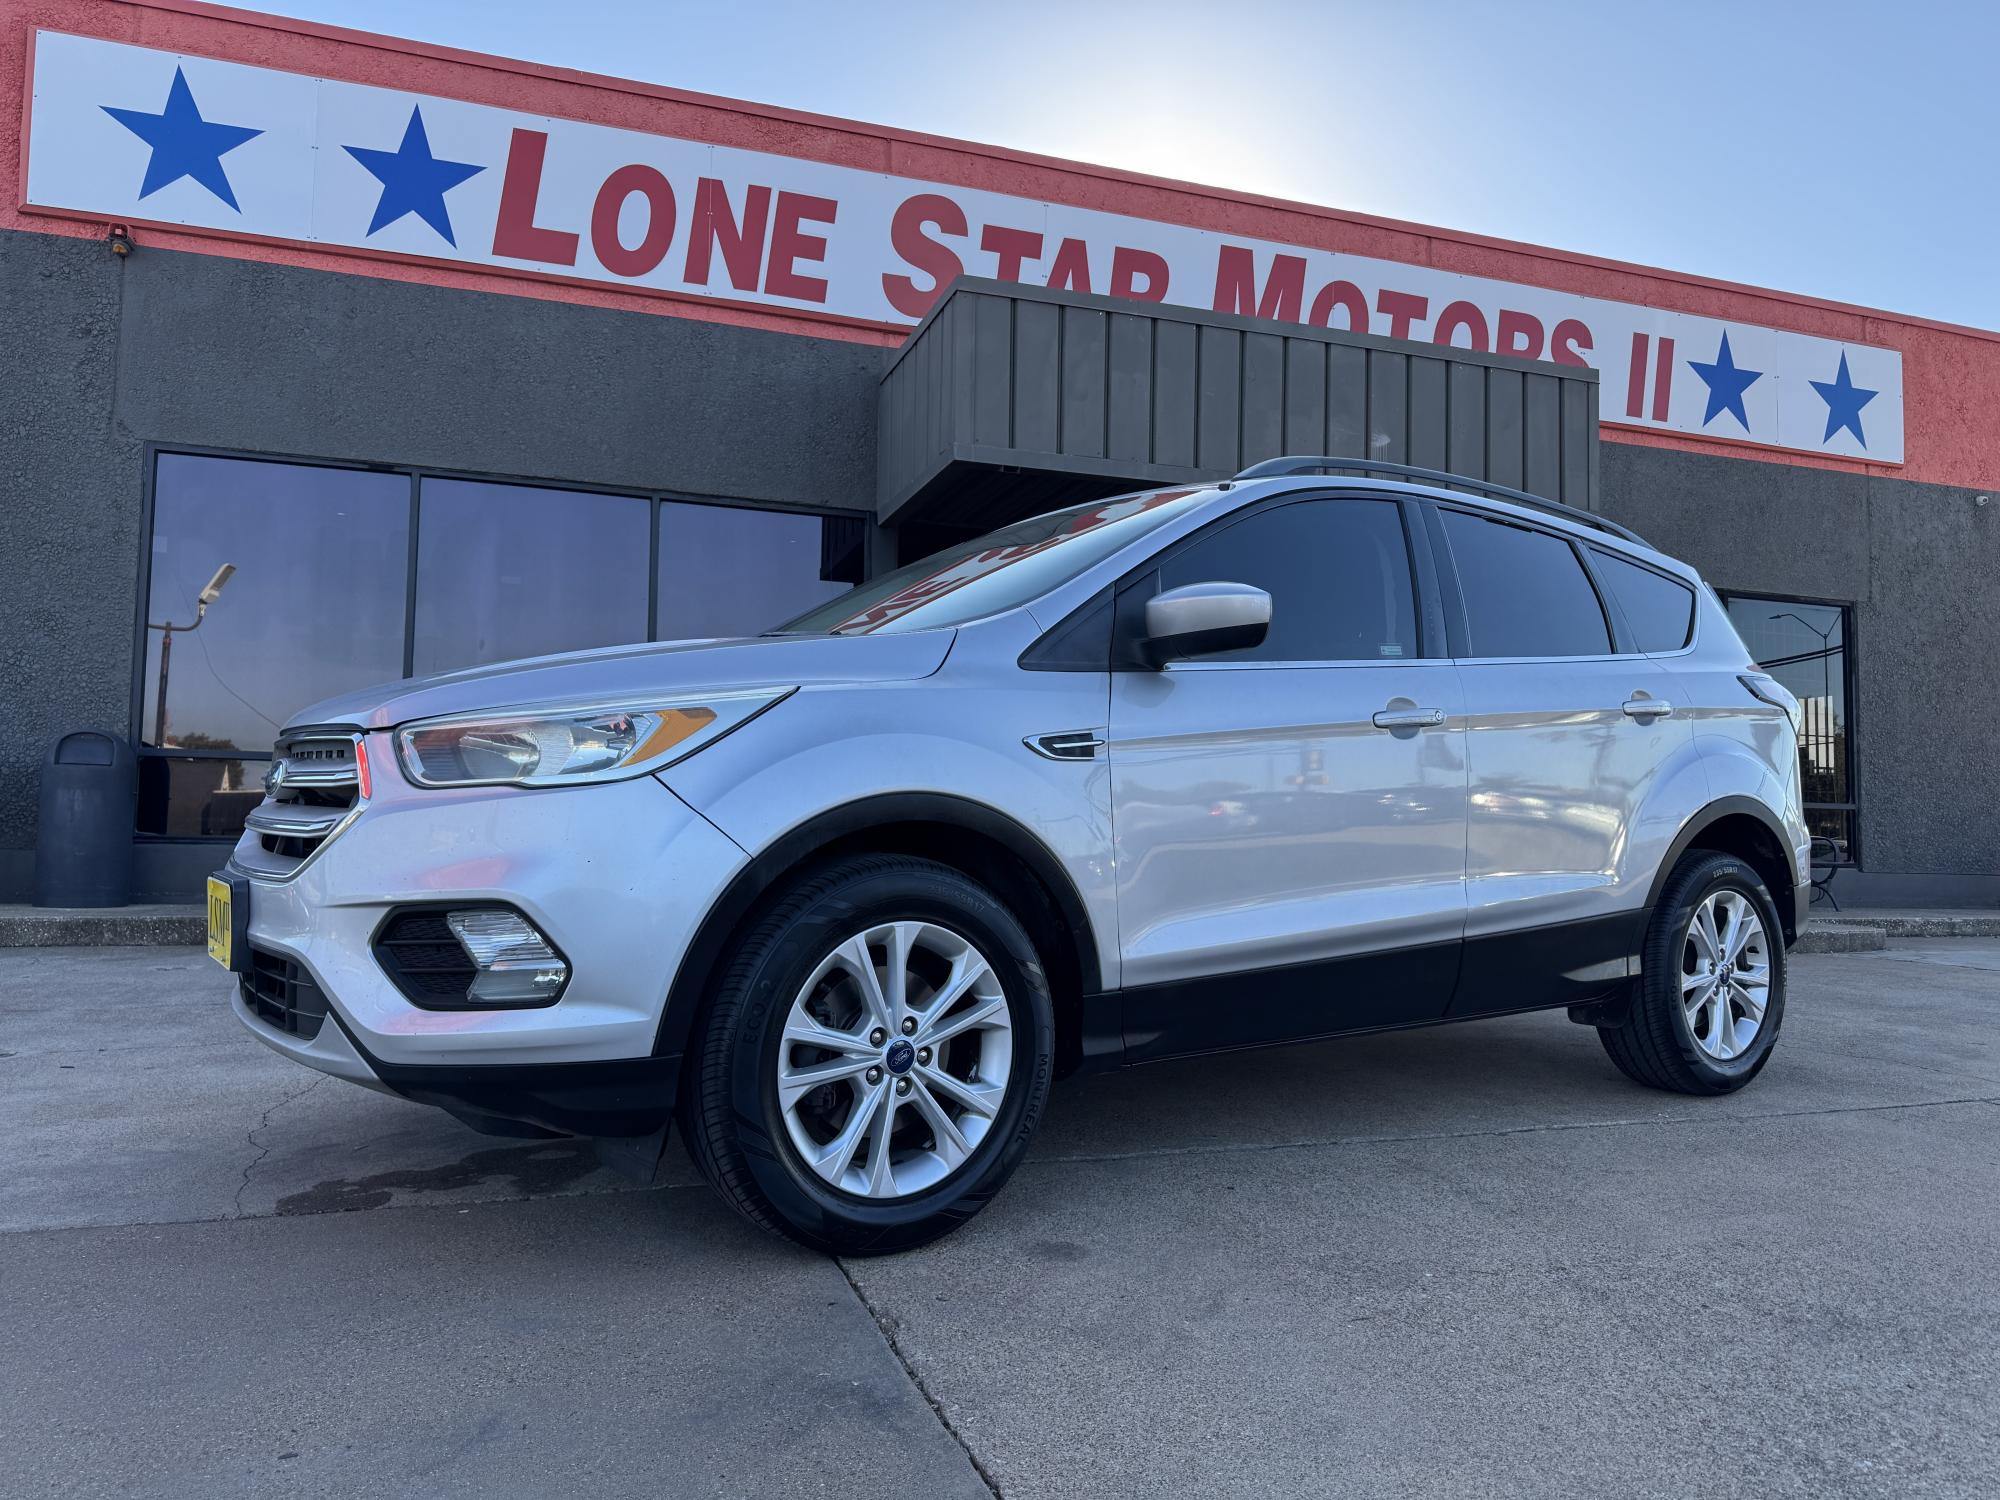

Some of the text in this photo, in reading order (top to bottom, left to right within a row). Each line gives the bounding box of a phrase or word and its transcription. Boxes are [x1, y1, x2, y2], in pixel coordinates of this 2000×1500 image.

[491, 126, 1675, 422] LONE STAR MOTORS II
[1015, 1053, 1049, 1144] MONTREAL
